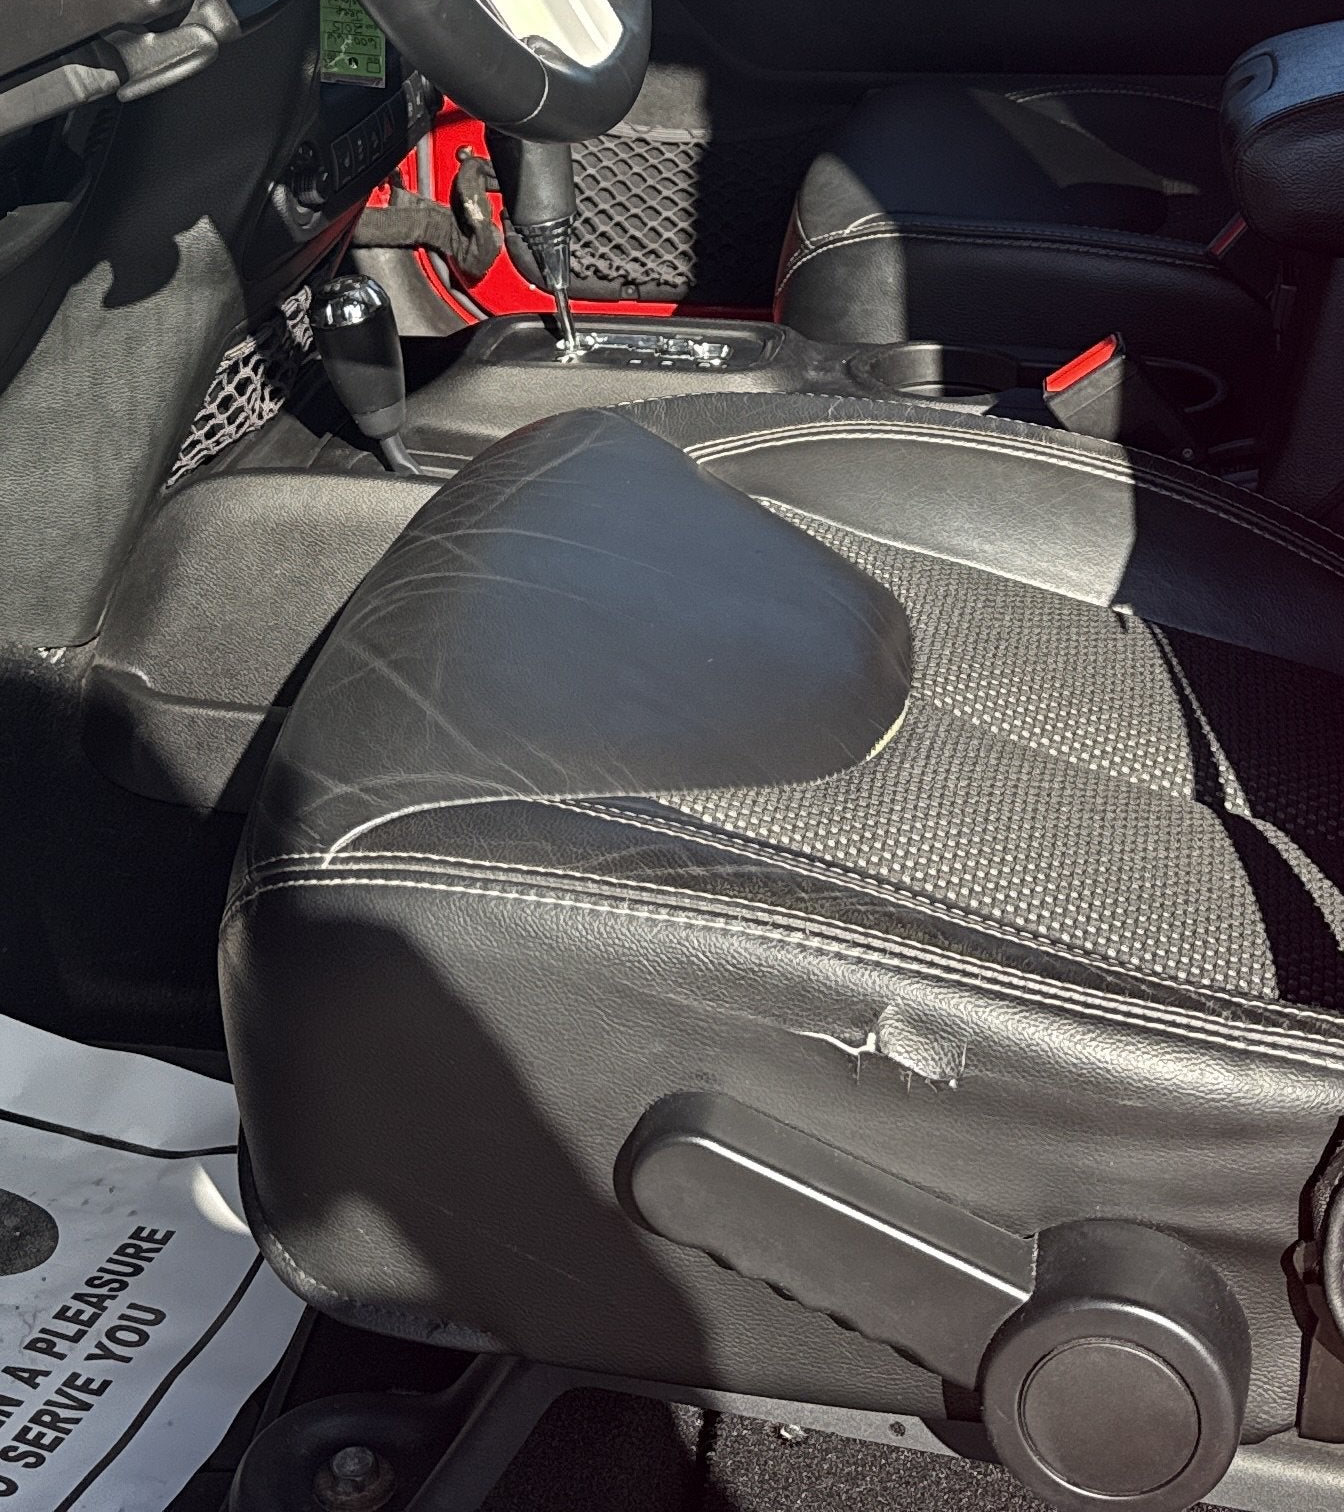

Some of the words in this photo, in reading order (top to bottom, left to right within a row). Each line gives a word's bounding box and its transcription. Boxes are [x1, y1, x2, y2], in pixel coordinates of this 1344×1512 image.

[23, 1226, 176, 1361] PLEASURE
[84, 1303, 167, 1364] YOU
[1, 1365, 52, 1389] A
